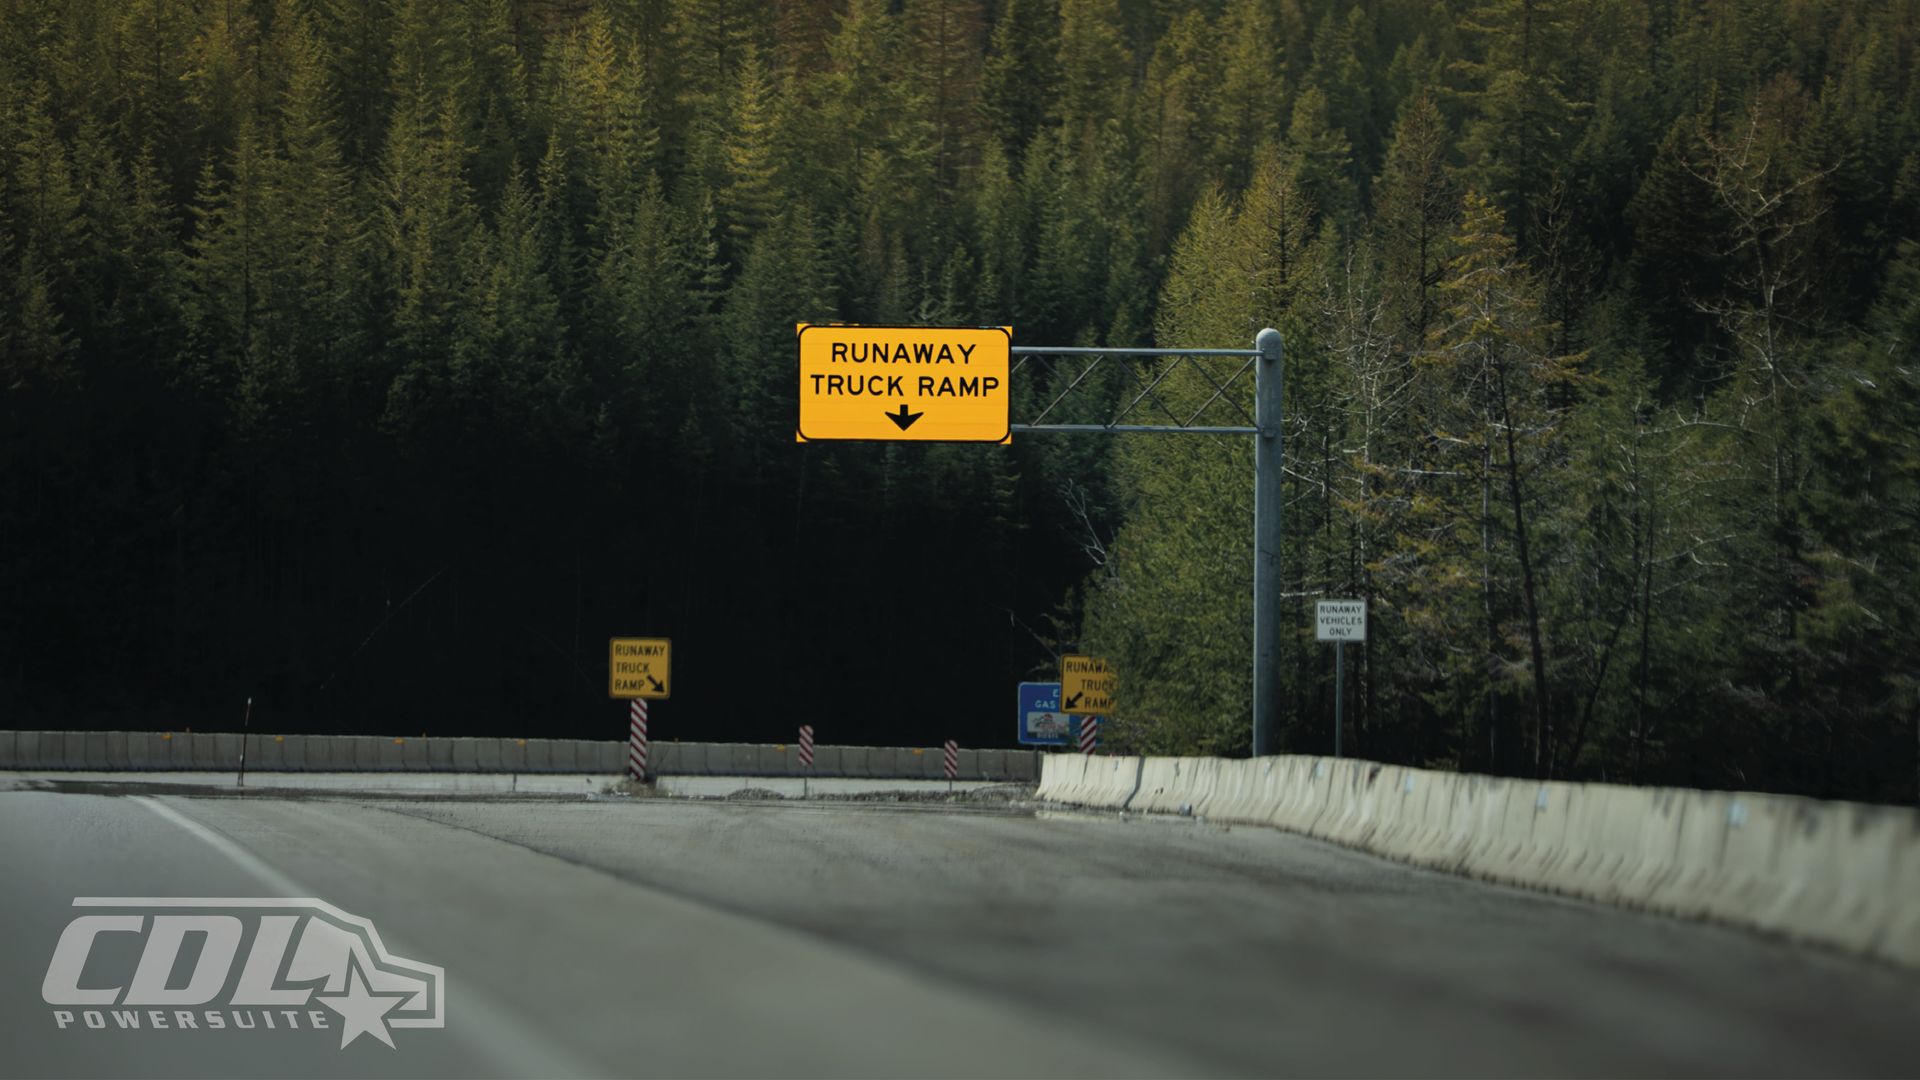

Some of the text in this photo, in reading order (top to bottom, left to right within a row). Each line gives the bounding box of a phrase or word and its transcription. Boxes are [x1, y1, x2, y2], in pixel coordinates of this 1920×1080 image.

[831, 342, 977, 365] RUNAWAY
[810, 374, 1000, 398] TRUCK RAMP
[1319, 605, 1362, 614] RUNAWAY
[1319, 617, 1363, 626] VEHICLES
[1329, 628, 1352, 637] ONLY
[615, 644, 666, 656] RUNAWAY
[616, 662, 650, 674] TRUCK
[1066, 661, 1109, 673] RUNAWA
[615, 679, 645, 691] RAMP
[1034, 700, 1056, 709] GAS
